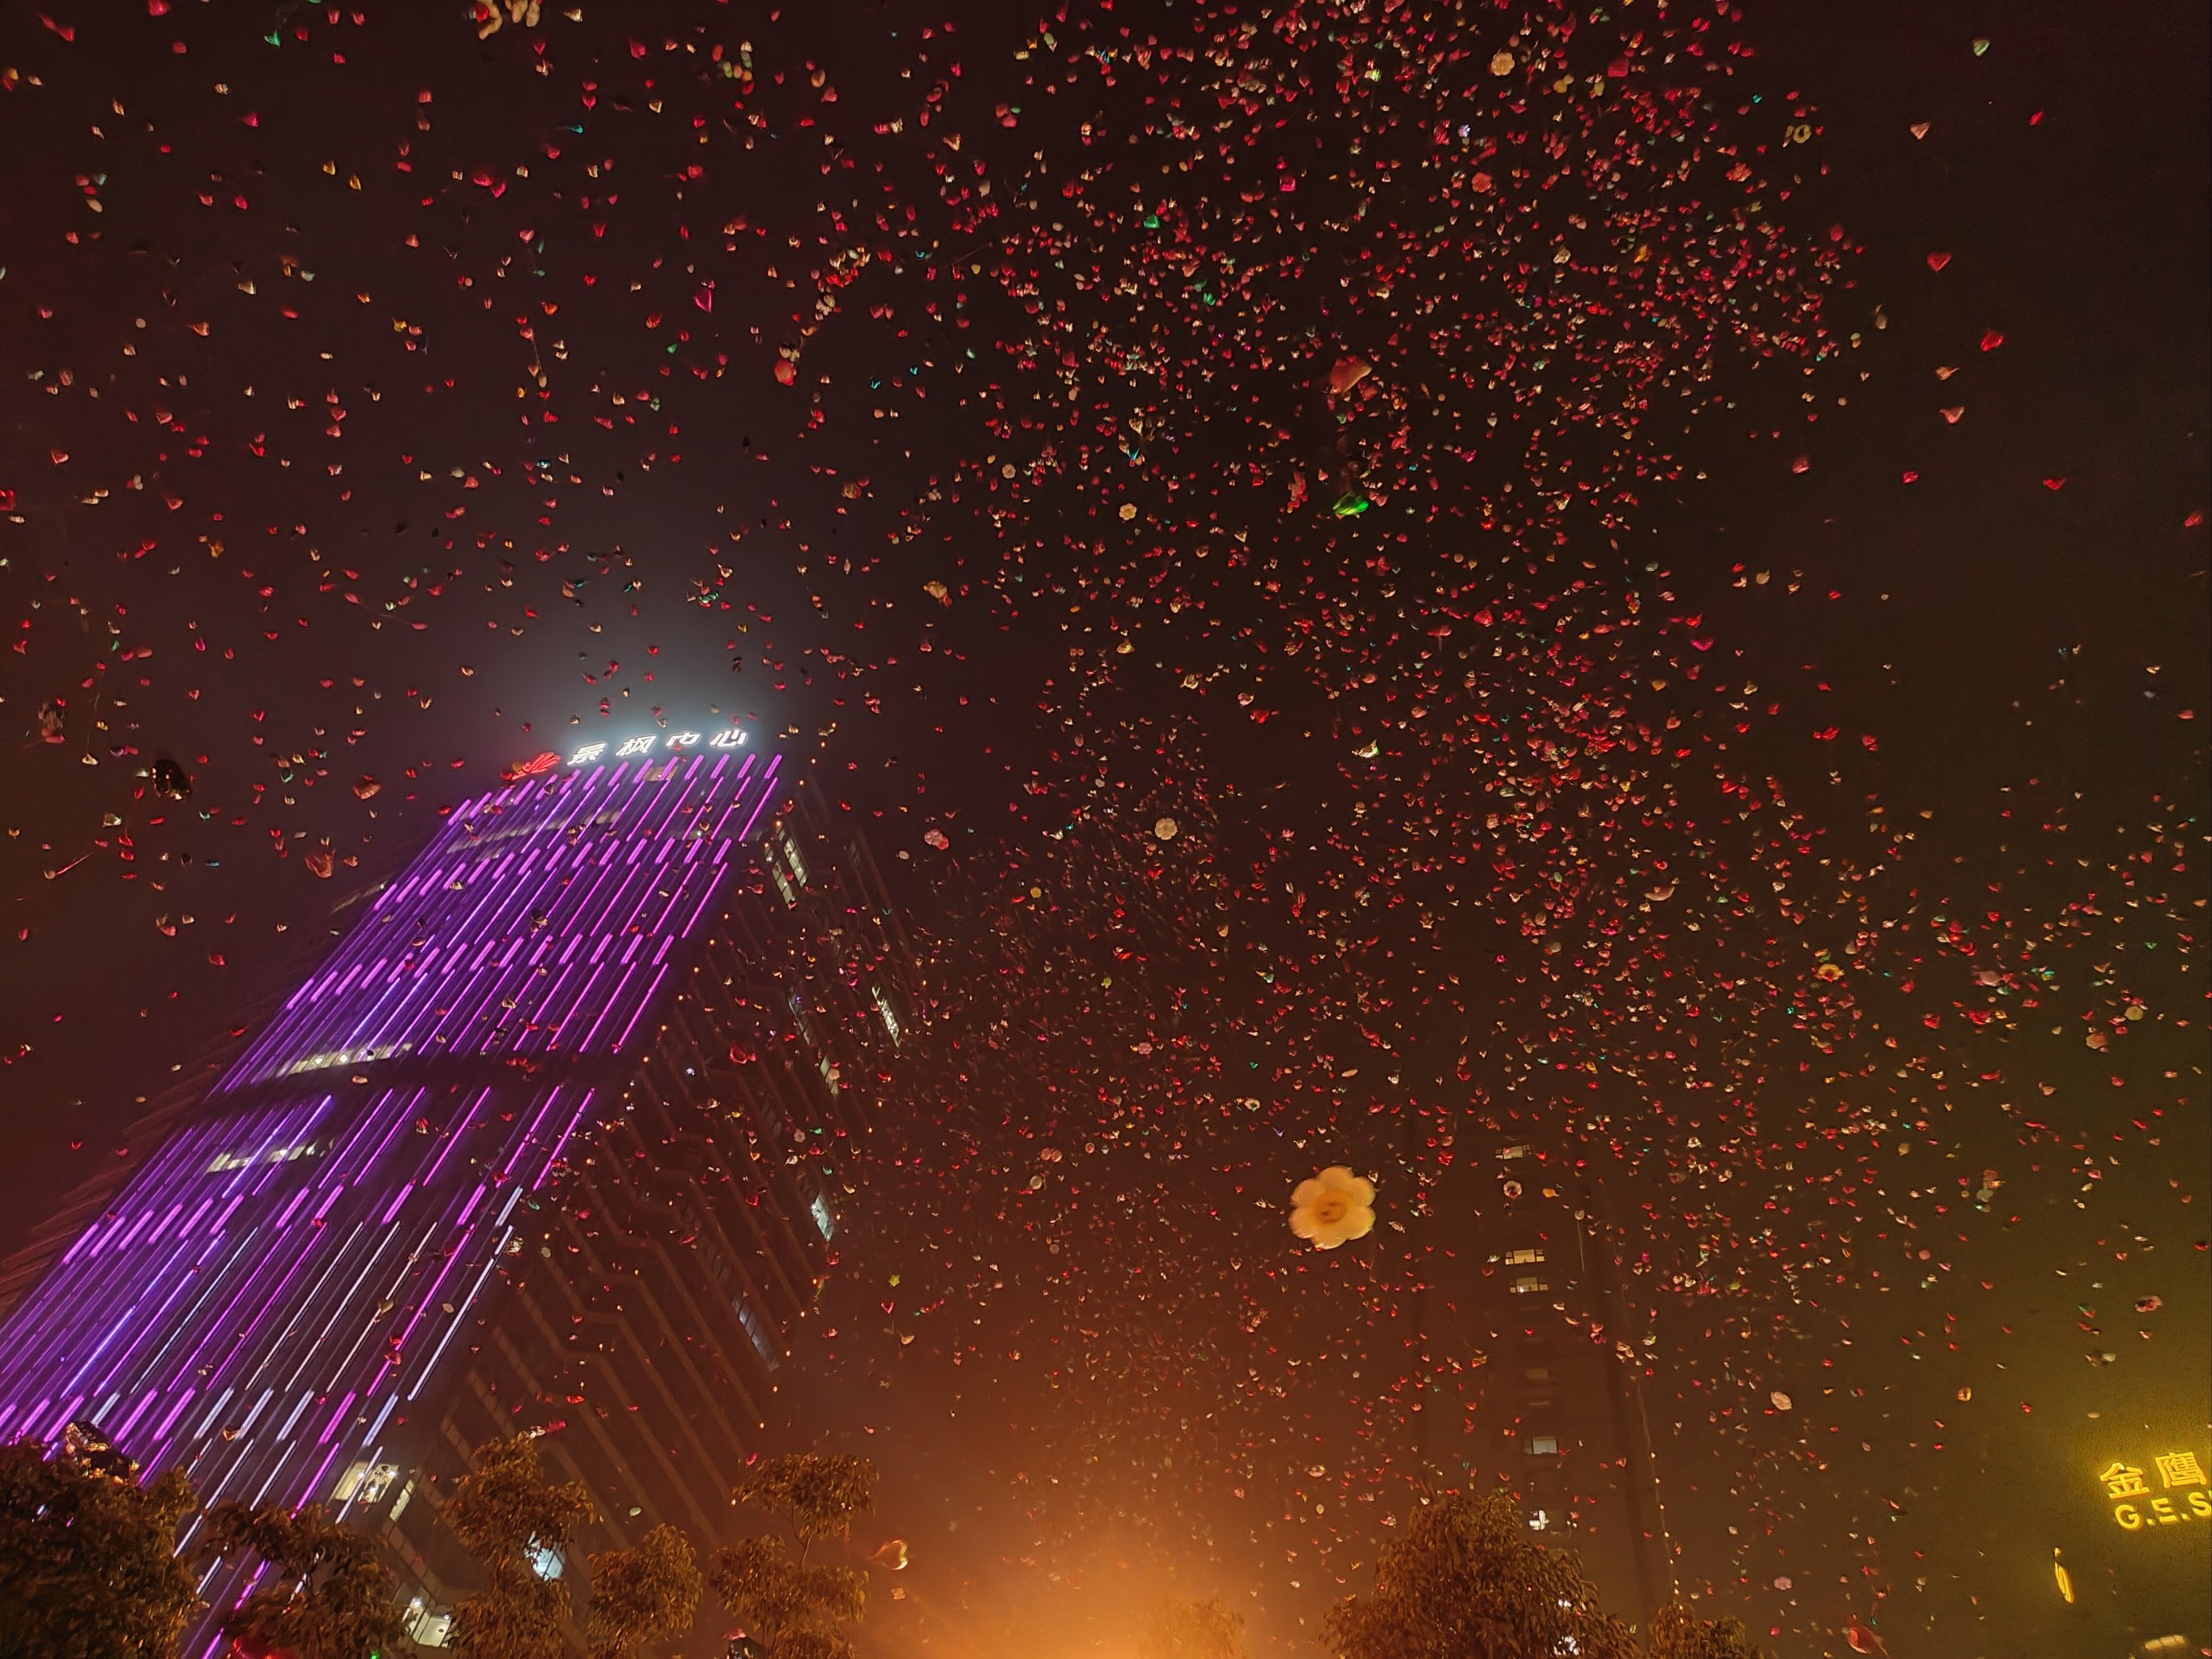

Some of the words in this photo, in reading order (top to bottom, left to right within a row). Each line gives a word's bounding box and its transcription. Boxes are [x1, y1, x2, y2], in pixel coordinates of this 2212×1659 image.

[567, 728, 749, 766] 景枫中心
[2115, 1490, 2212, 1530] G.E.S
